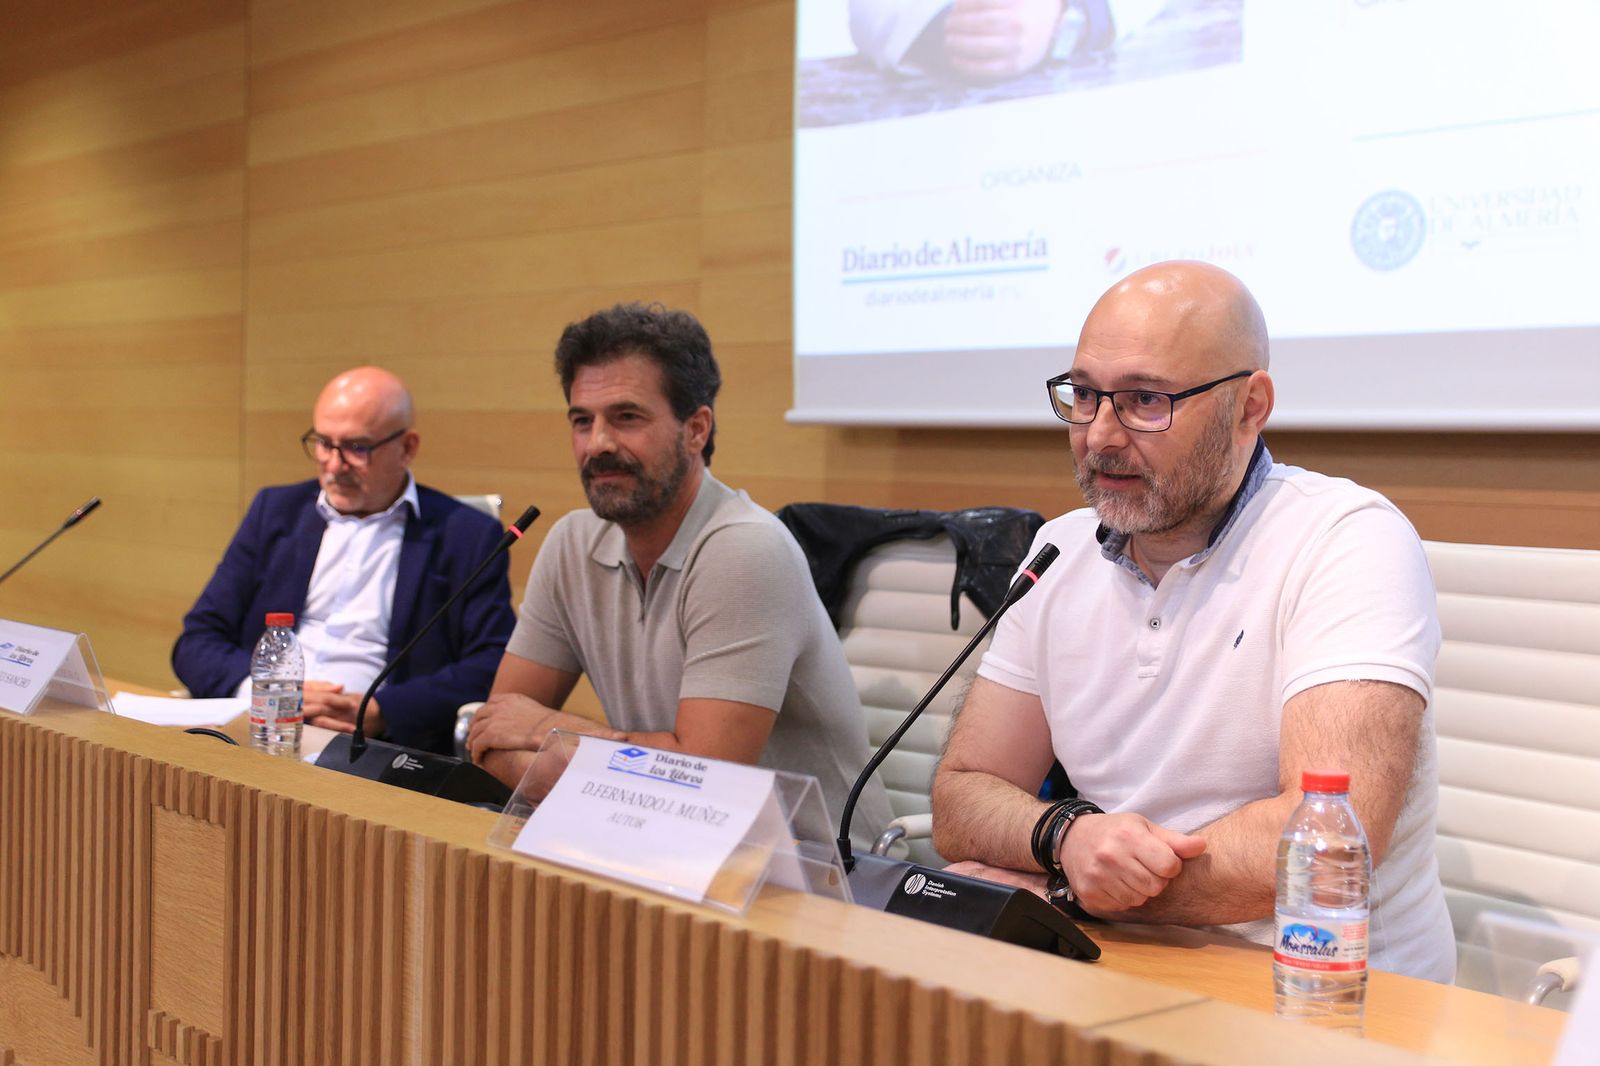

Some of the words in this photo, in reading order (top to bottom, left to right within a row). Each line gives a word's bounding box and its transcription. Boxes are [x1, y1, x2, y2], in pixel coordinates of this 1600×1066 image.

[979, 160, 1083, 191] ORGANIZA
[841, 242, 912, 273] Diario
[914, 239, 944, 267] de
[945, 229, 1049, 265] Almería
[655, 753, 692, 768] Diario
[693, 761, 708, 772] de
[649, 764, 666, 776] los
[669, 768, 704, 784] Libros
[606, 812, 647, 829] AUTOR
[925, 885, 957, 896] Interpretation
[928, 880, 944, 888] Danish
[922, 890, 942, 898] Systems
